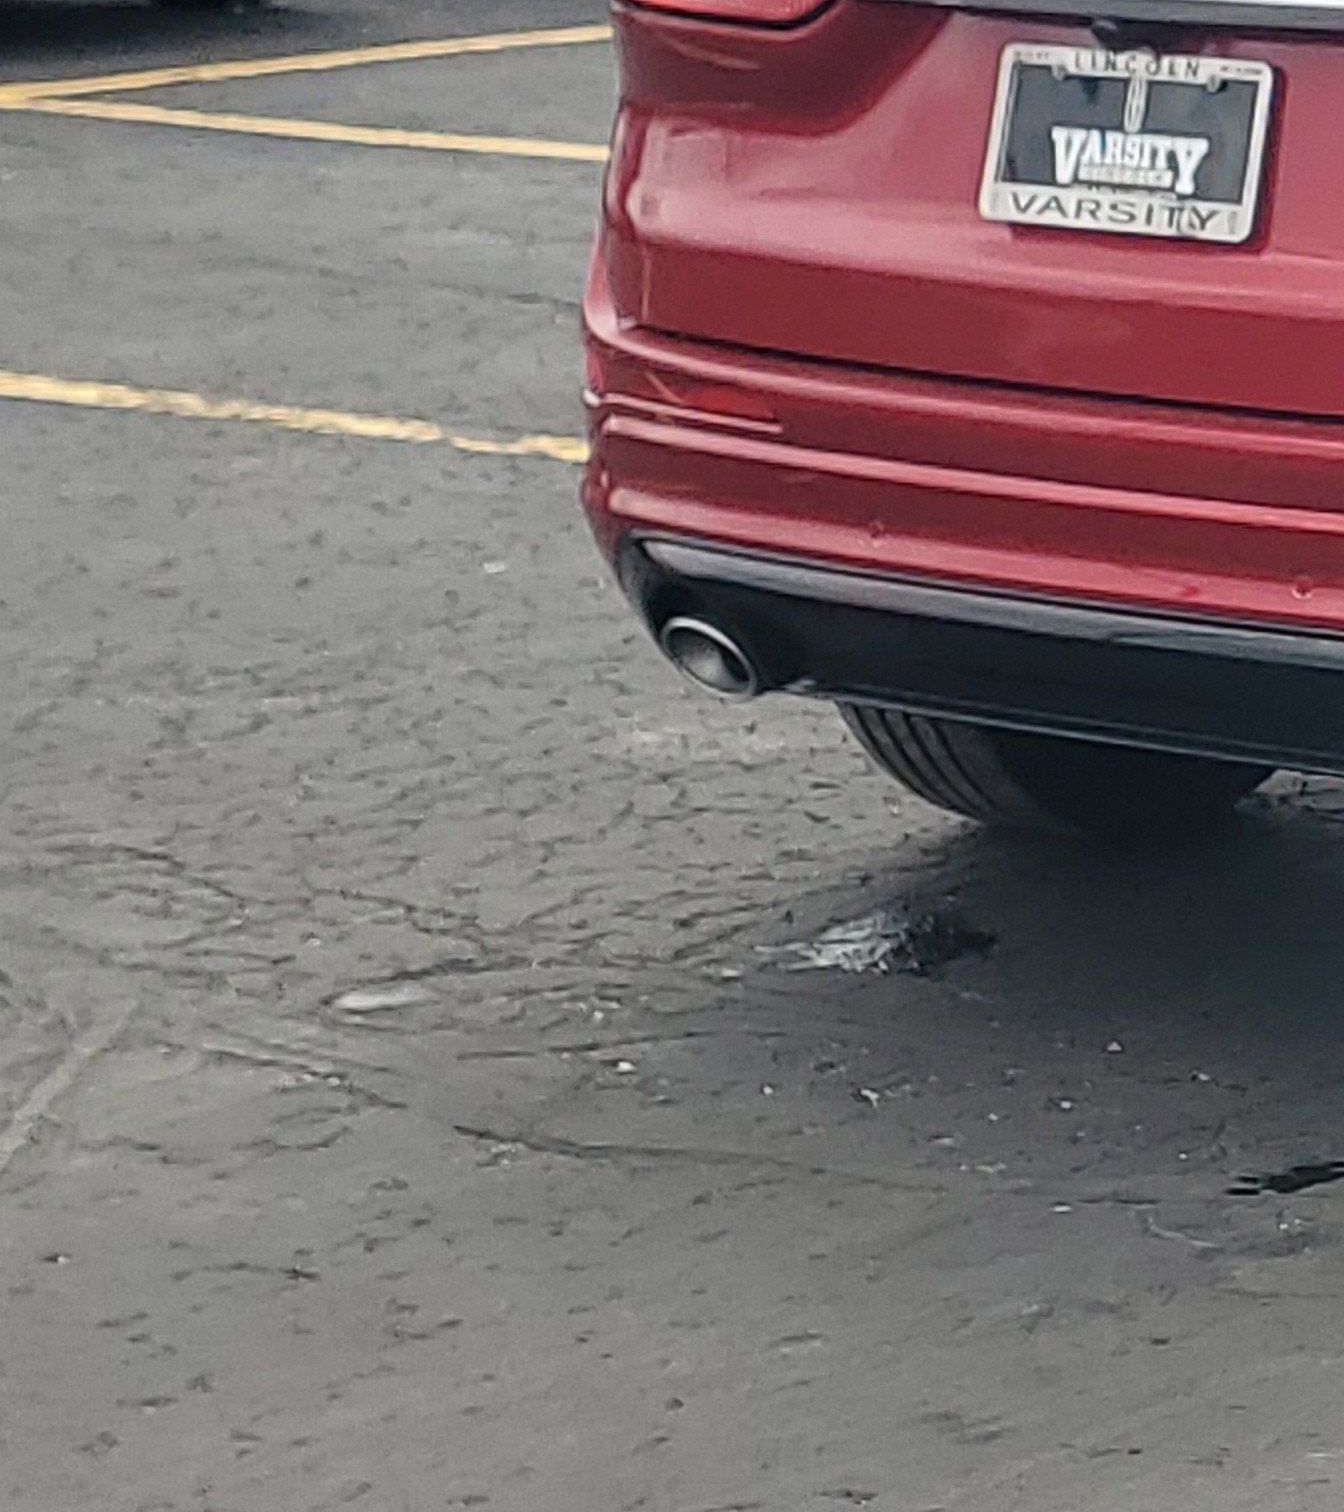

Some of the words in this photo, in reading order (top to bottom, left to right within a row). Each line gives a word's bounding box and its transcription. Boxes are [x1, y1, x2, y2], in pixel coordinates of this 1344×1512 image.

[1074, 49, 1200, 78] LINCOLN
[1050, 125, 1210, 195] VARSITY
[1010, 192, 1220, 232] VARSITY
